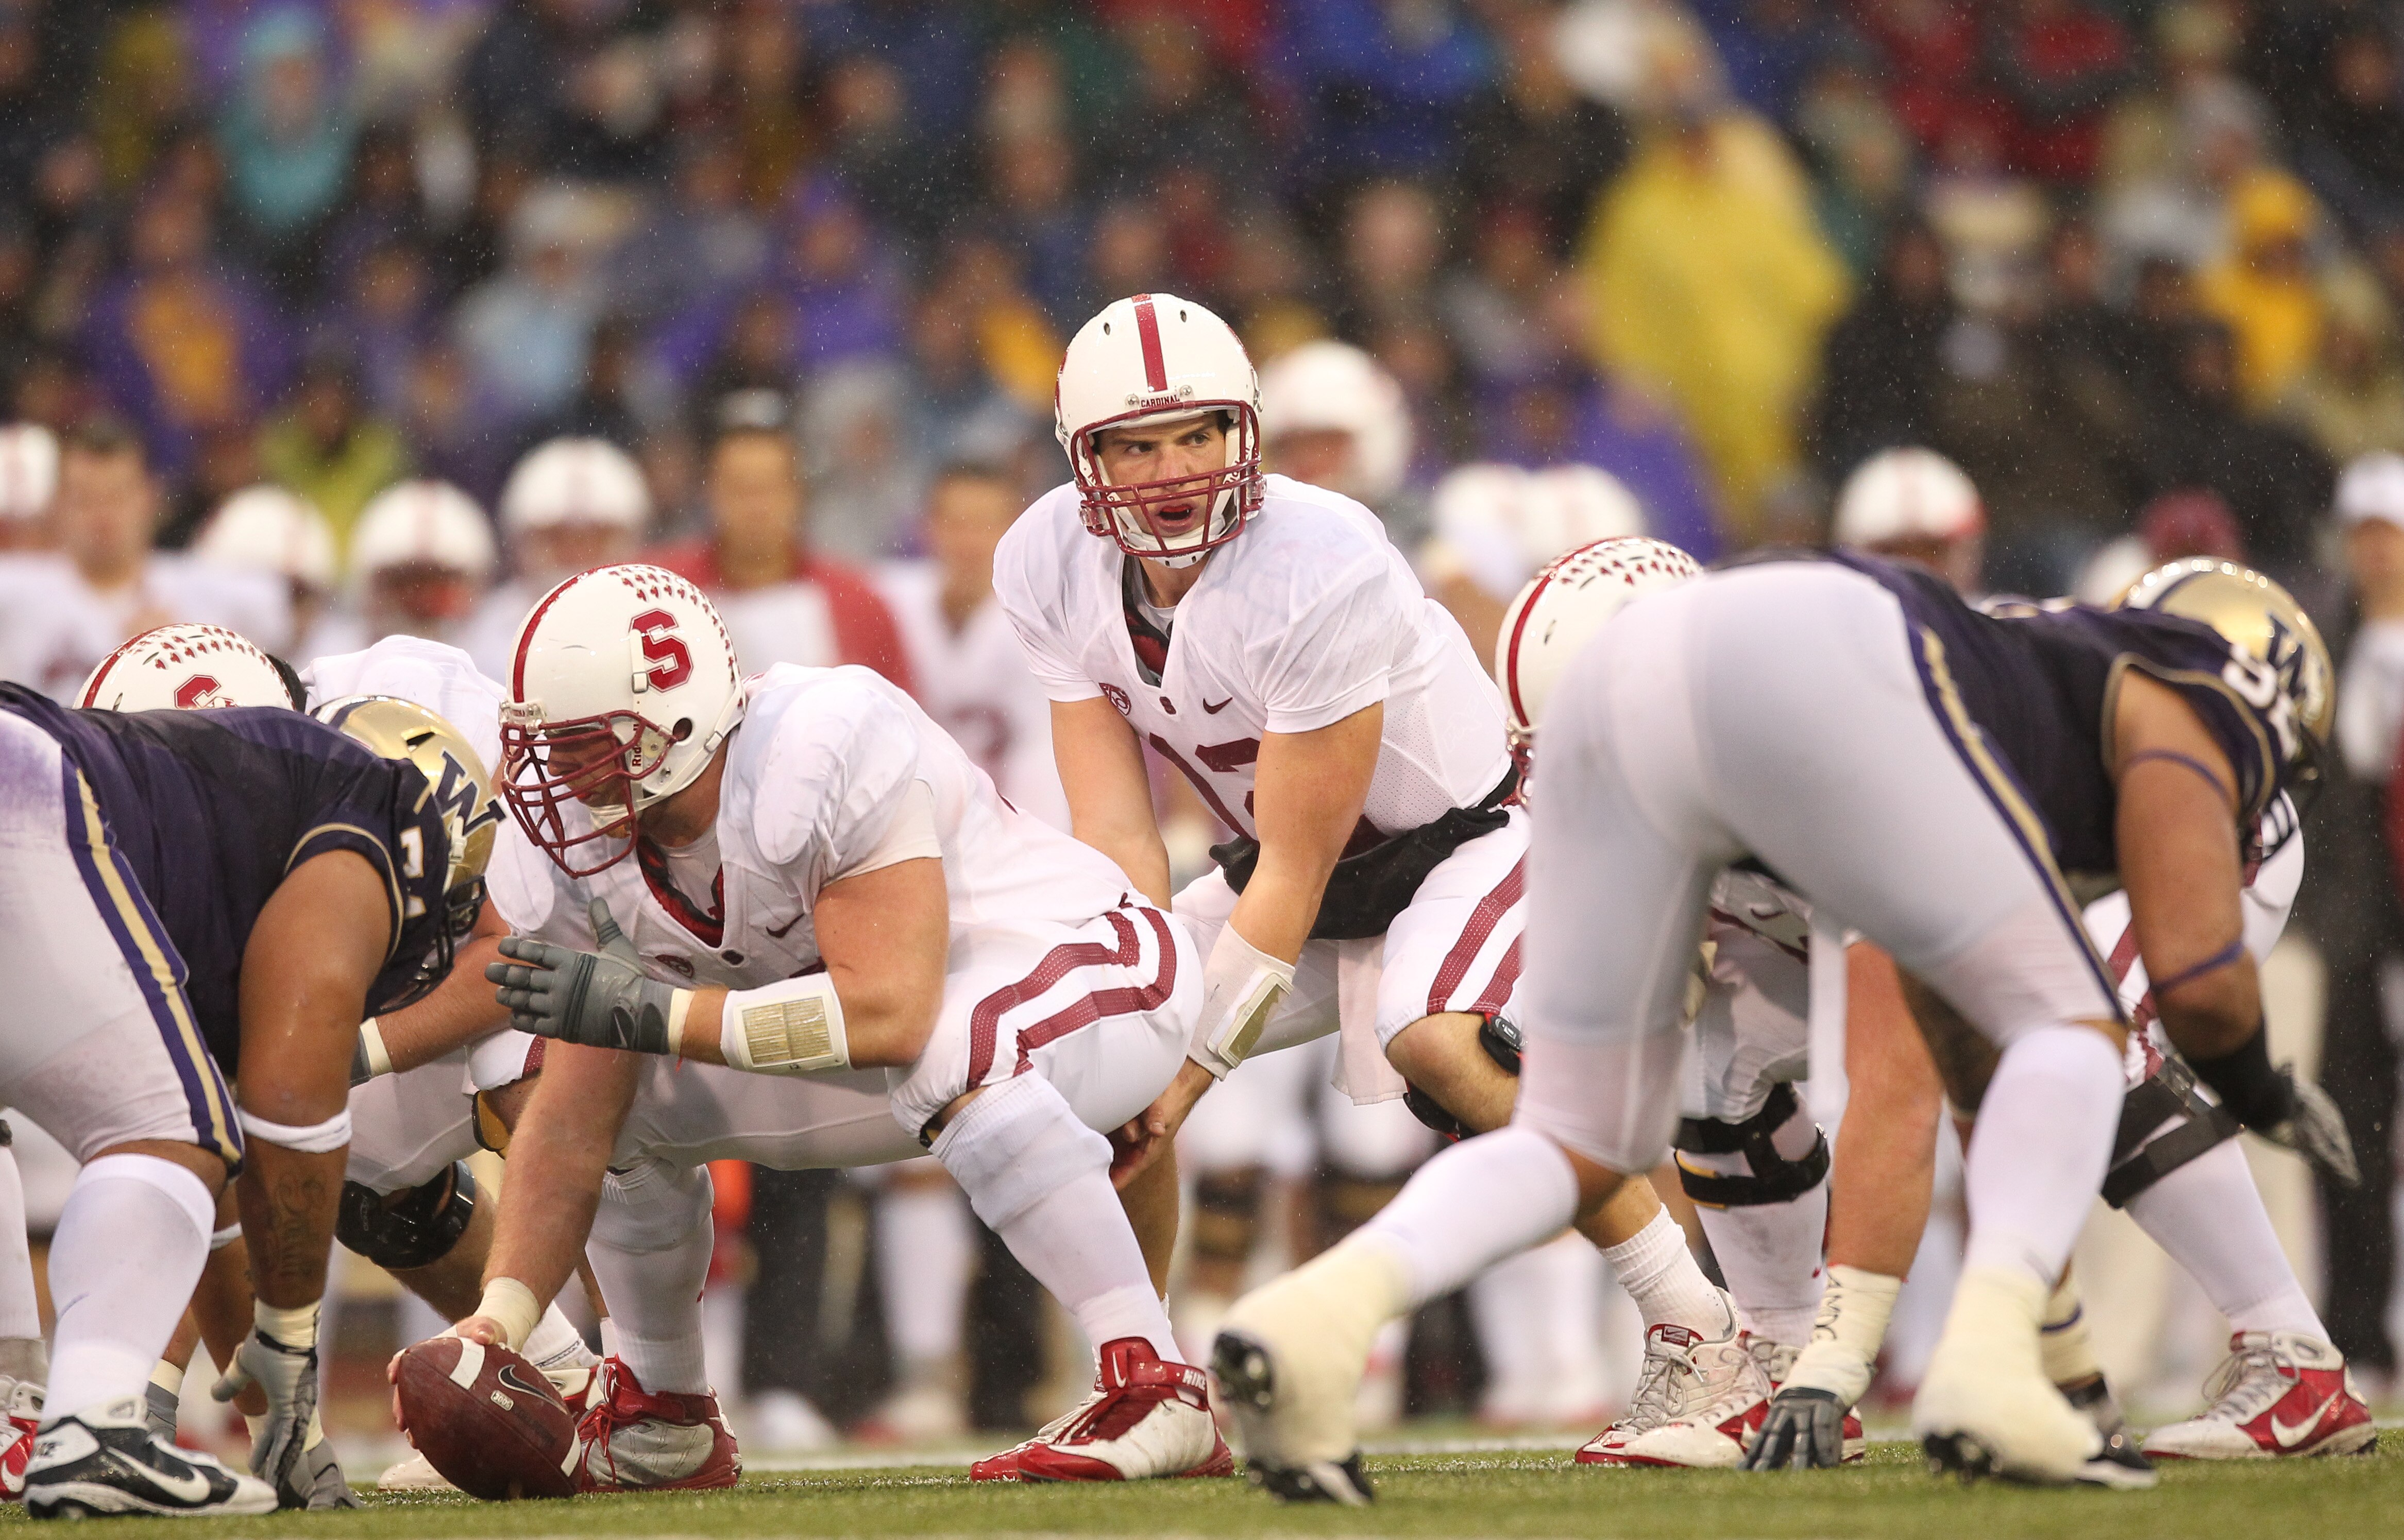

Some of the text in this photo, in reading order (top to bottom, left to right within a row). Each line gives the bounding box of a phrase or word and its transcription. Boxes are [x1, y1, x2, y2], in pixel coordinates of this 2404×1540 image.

[1141, 394, 1180, 408] CARDINAL
[629, 607, 694, 693] S
[434, 749, 507, 843] W
[1182, 1368, 1206, 1392] NIKE
